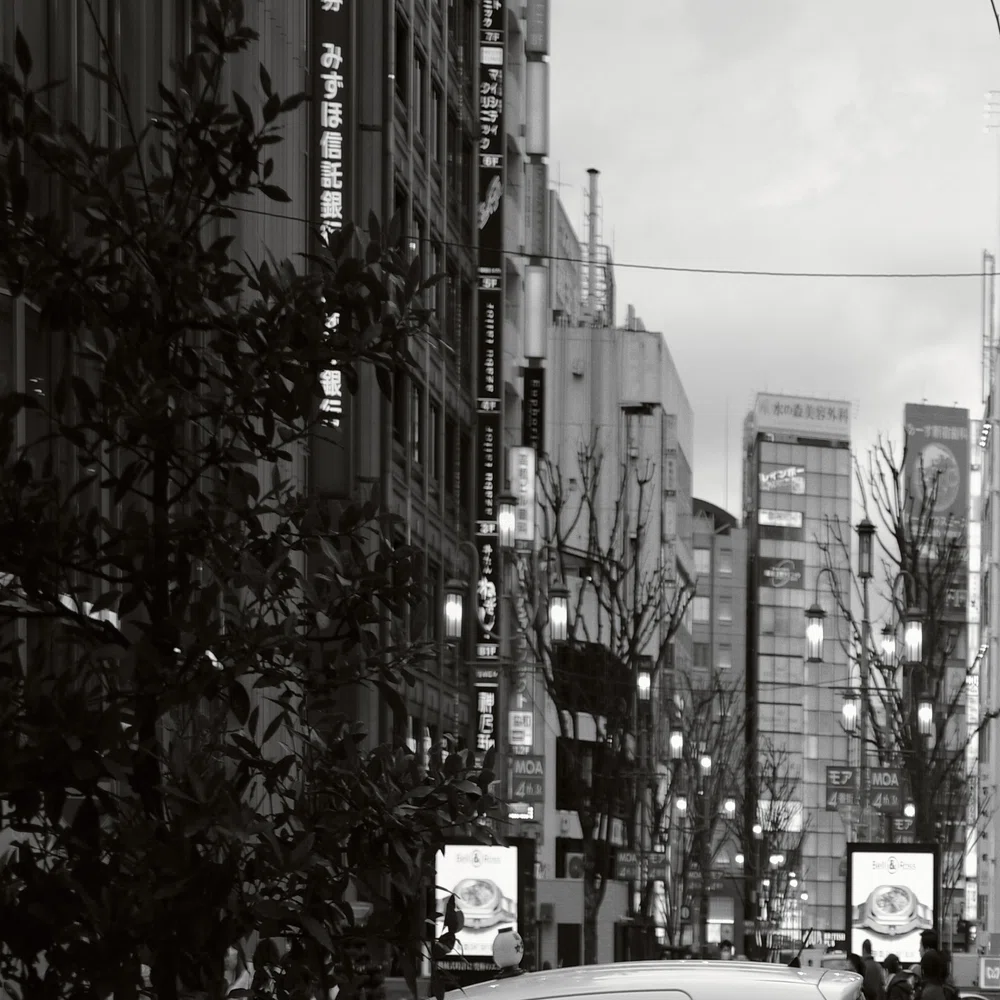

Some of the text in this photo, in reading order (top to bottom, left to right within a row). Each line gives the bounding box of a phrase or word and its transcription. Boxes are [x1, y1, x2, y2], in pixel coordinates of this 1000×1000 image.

[483, 302, 495, 393] azabu tailor
[774, 401, 848, 424] 水の森美容外科
[482, 425, 494, 516] azabu tailor
[515, 760, 543, 774] MOA
[828, 770, 852, 785] モア
[872, 772, 899, 786] MOA
[894, 818, 914, 830] モア
